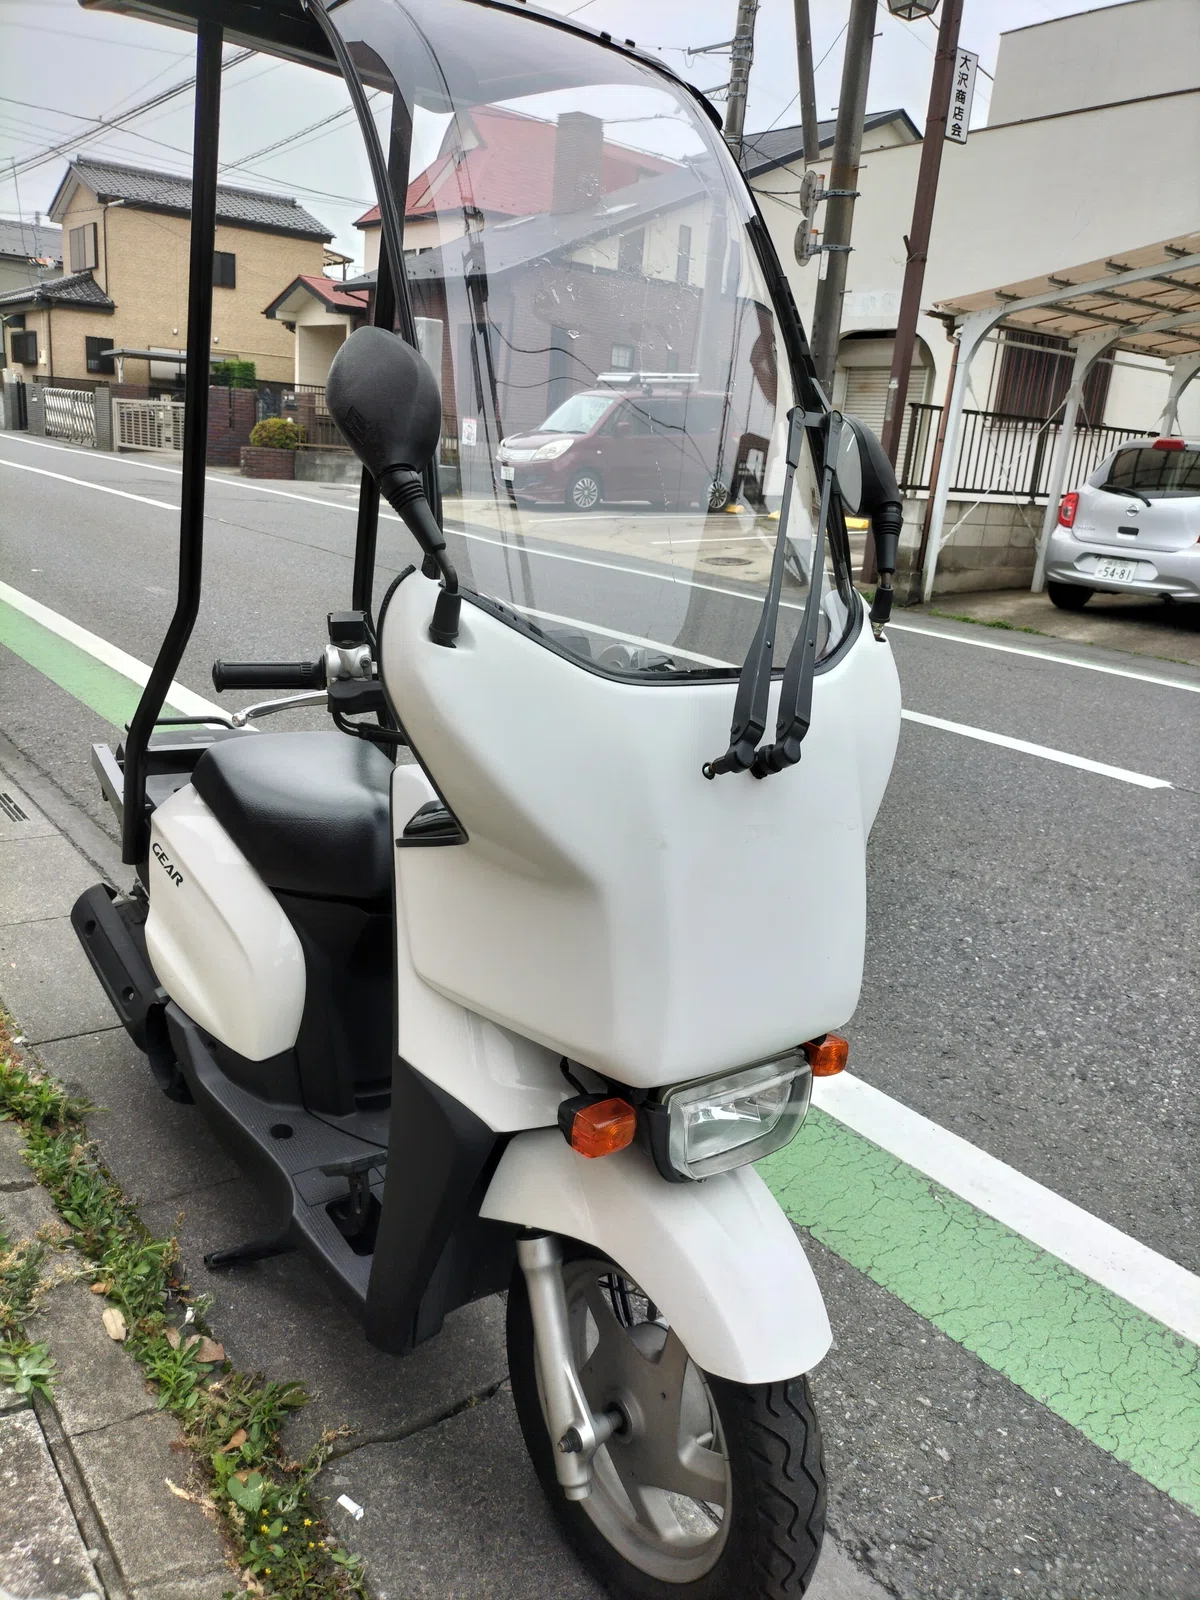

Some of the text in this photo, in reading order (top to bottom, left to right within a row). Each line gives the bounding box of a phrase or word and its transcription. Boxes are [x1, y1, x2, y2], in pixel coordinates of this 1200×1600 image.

[951, 55, 971, 137] 大沢商店会
[1102, 566, 1131, 580] 54-81
[152, 842, 184, 888] GEAR
